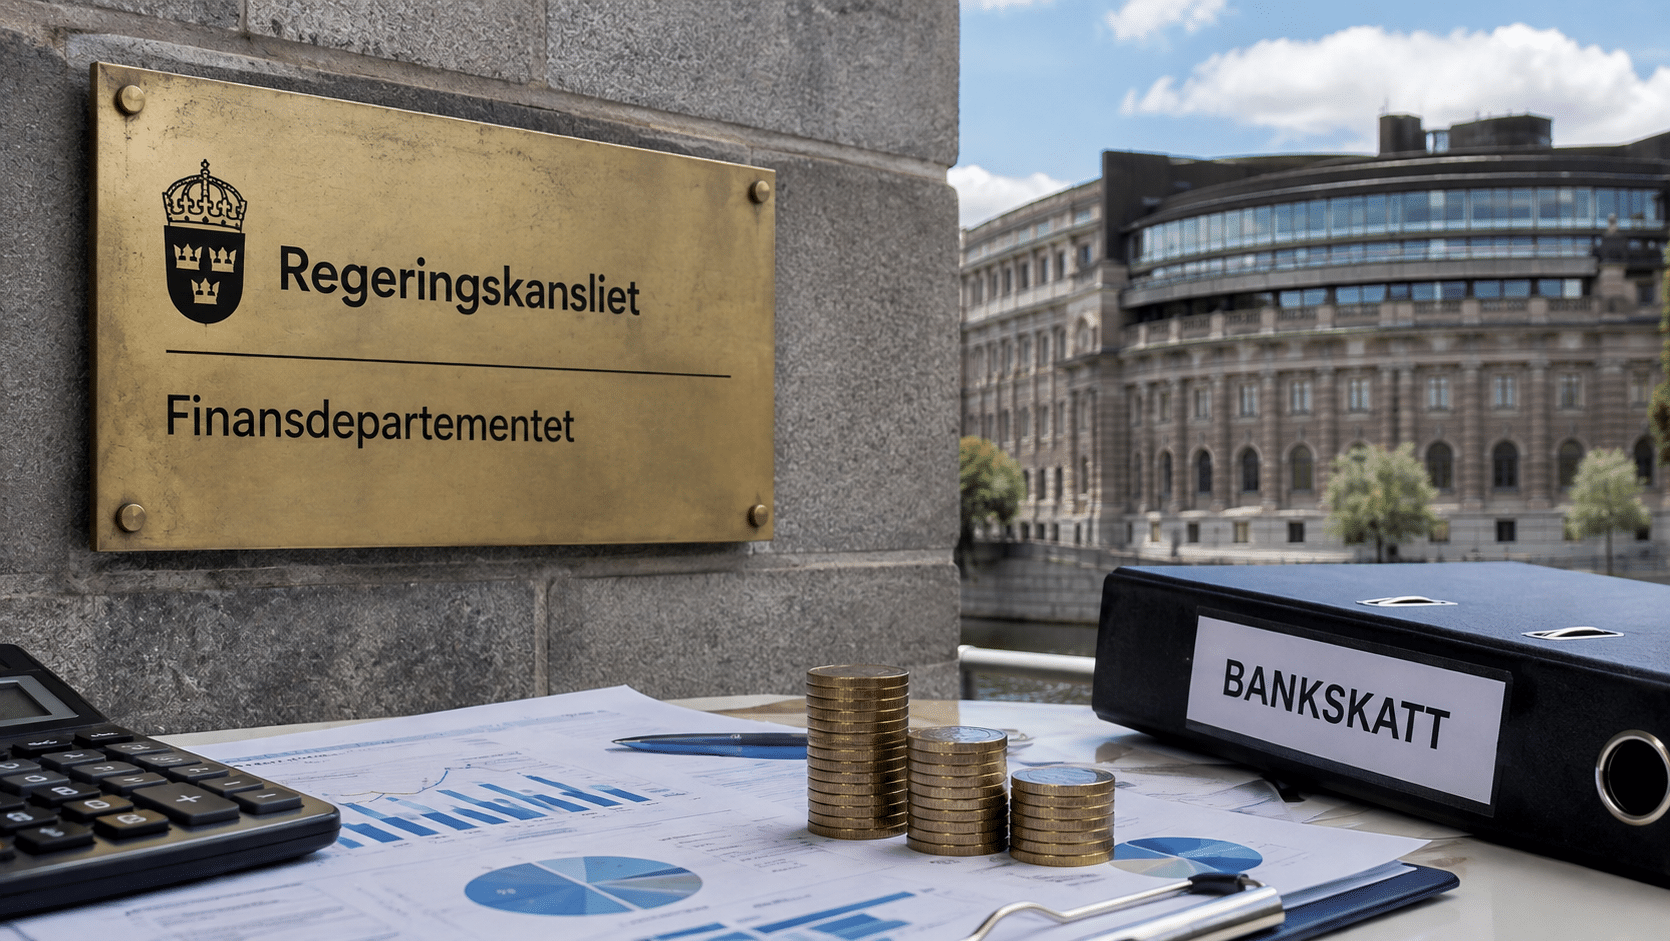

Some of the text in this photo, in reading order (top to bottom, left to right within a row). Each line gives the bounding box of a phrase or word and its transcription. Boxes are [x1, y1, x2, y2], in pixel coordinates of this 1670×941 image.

[280, 245, 640, 316] Regeringskansliet
[167, 394, 575, 449] Finansdepartementet
[1222, 658, 1451, 750] BANKSKATT
